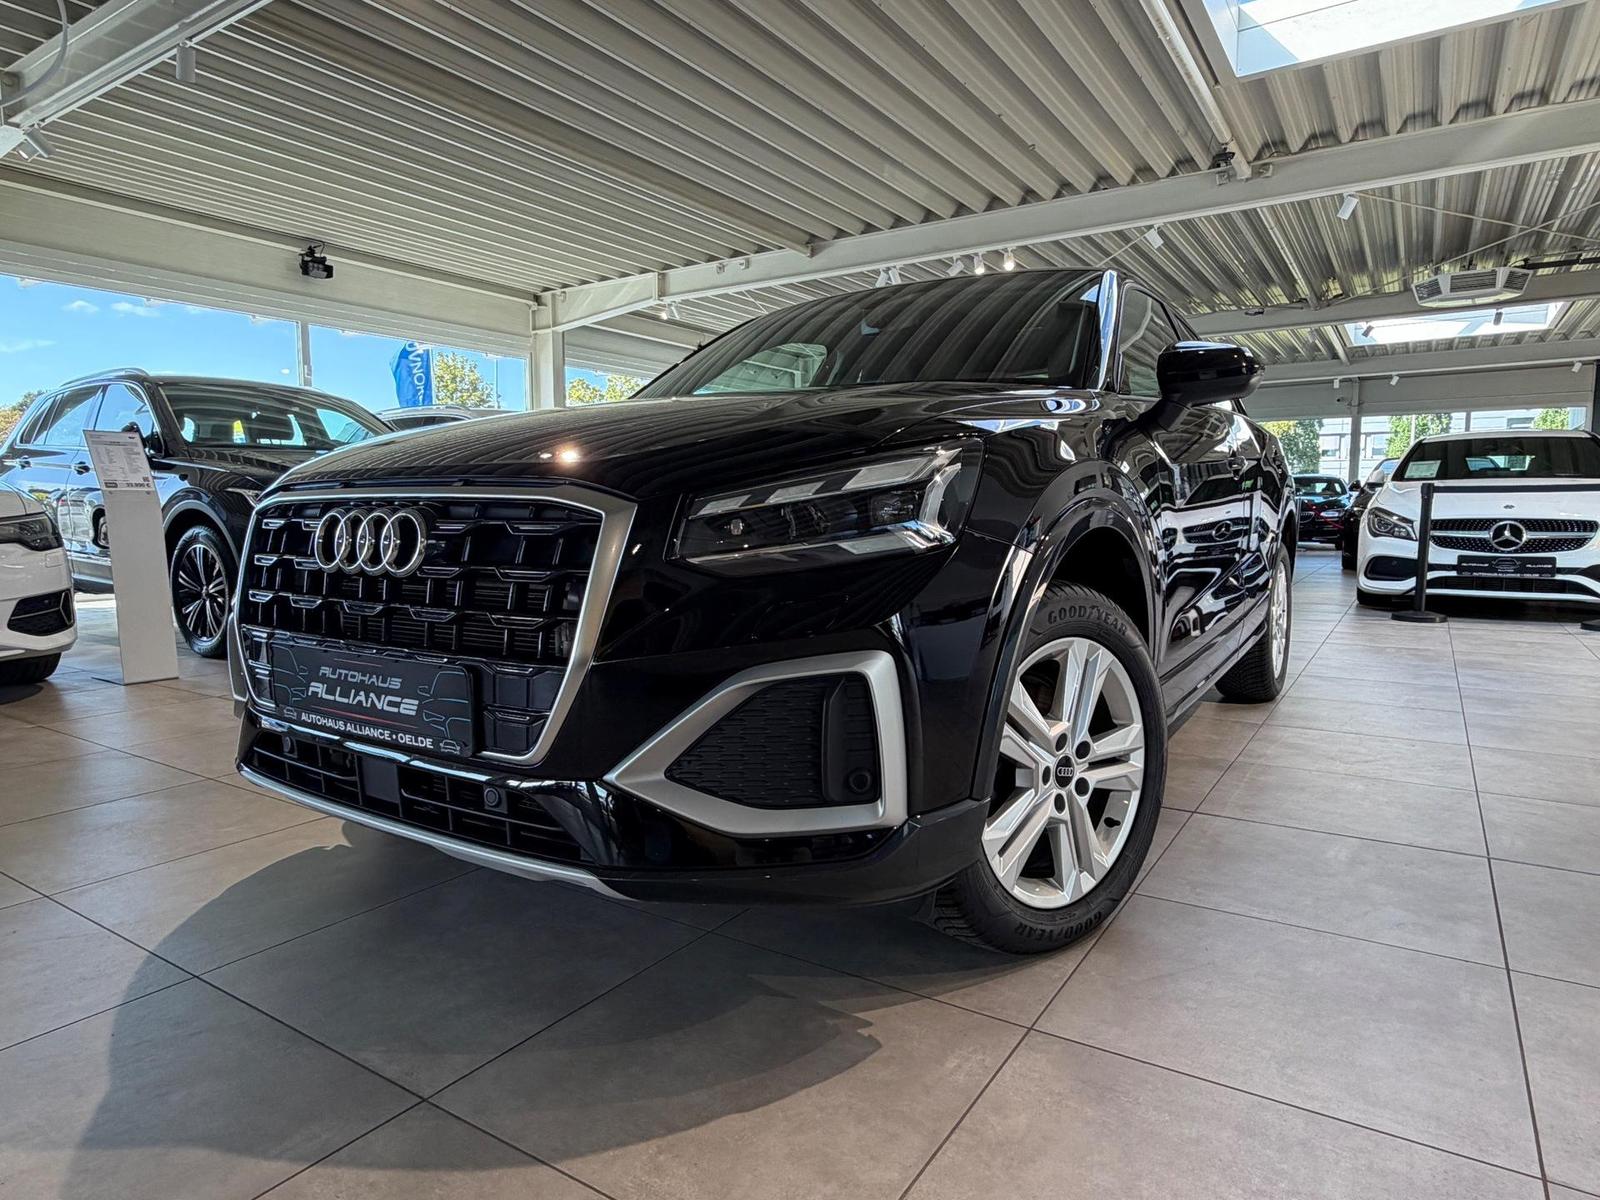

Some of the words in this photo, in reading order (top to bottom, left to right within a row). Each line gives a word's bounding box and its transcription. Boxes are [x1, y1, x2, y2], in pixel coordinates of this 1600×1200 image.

[1048, 605, 1128, 636] GOODYEAR
[319, 666, 403, 689] AUTOHAUS
[308, 681, 419, 716] ALLIANCE
[301, 711, 346, 731] AUTOHAUS
[346, 722, 391, 741] ALLIANCE
[397, 733, 434, 749] OELDE
